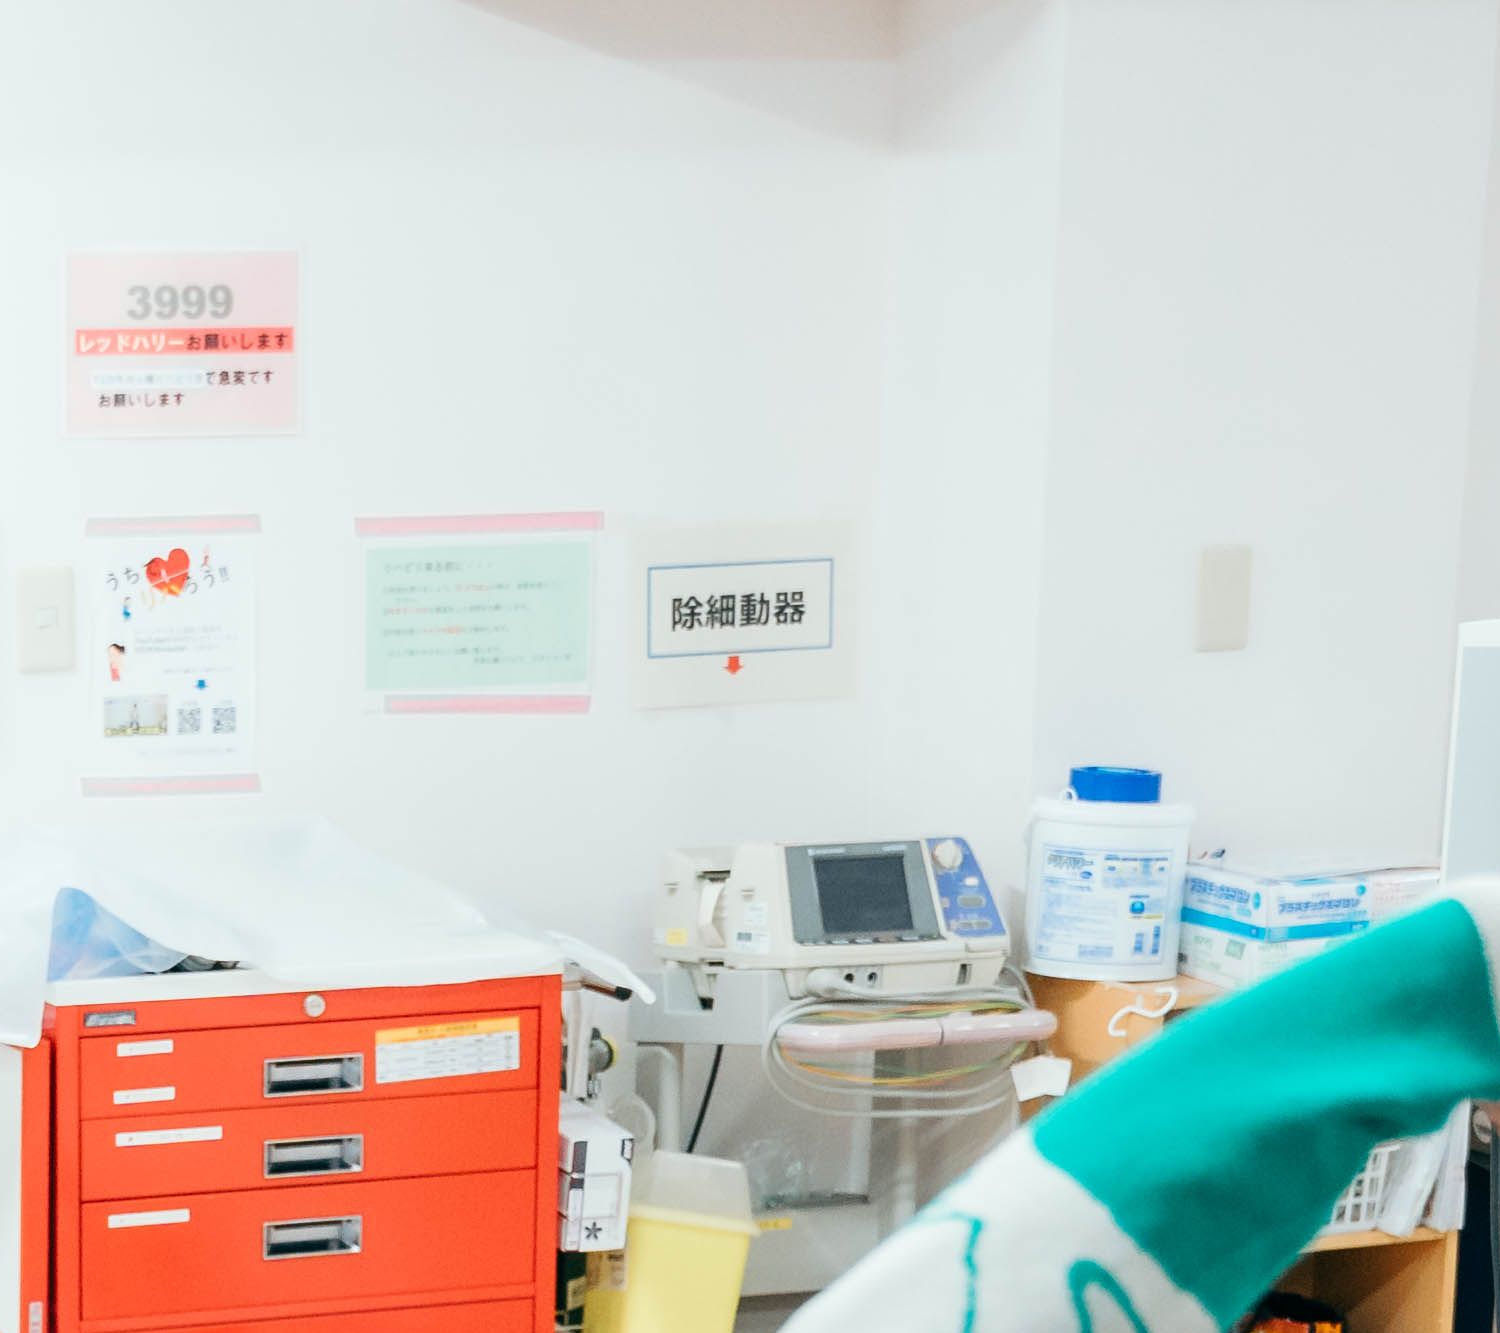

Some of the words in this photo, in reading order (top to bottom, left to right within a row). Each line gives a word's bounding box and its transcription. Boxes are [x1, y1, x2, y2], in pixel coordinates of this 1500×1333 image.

[126, 285, 234, 320] 3999
[96, 391, 187, 409] お願いします
[671, 590, 807, 632] 除細動器
